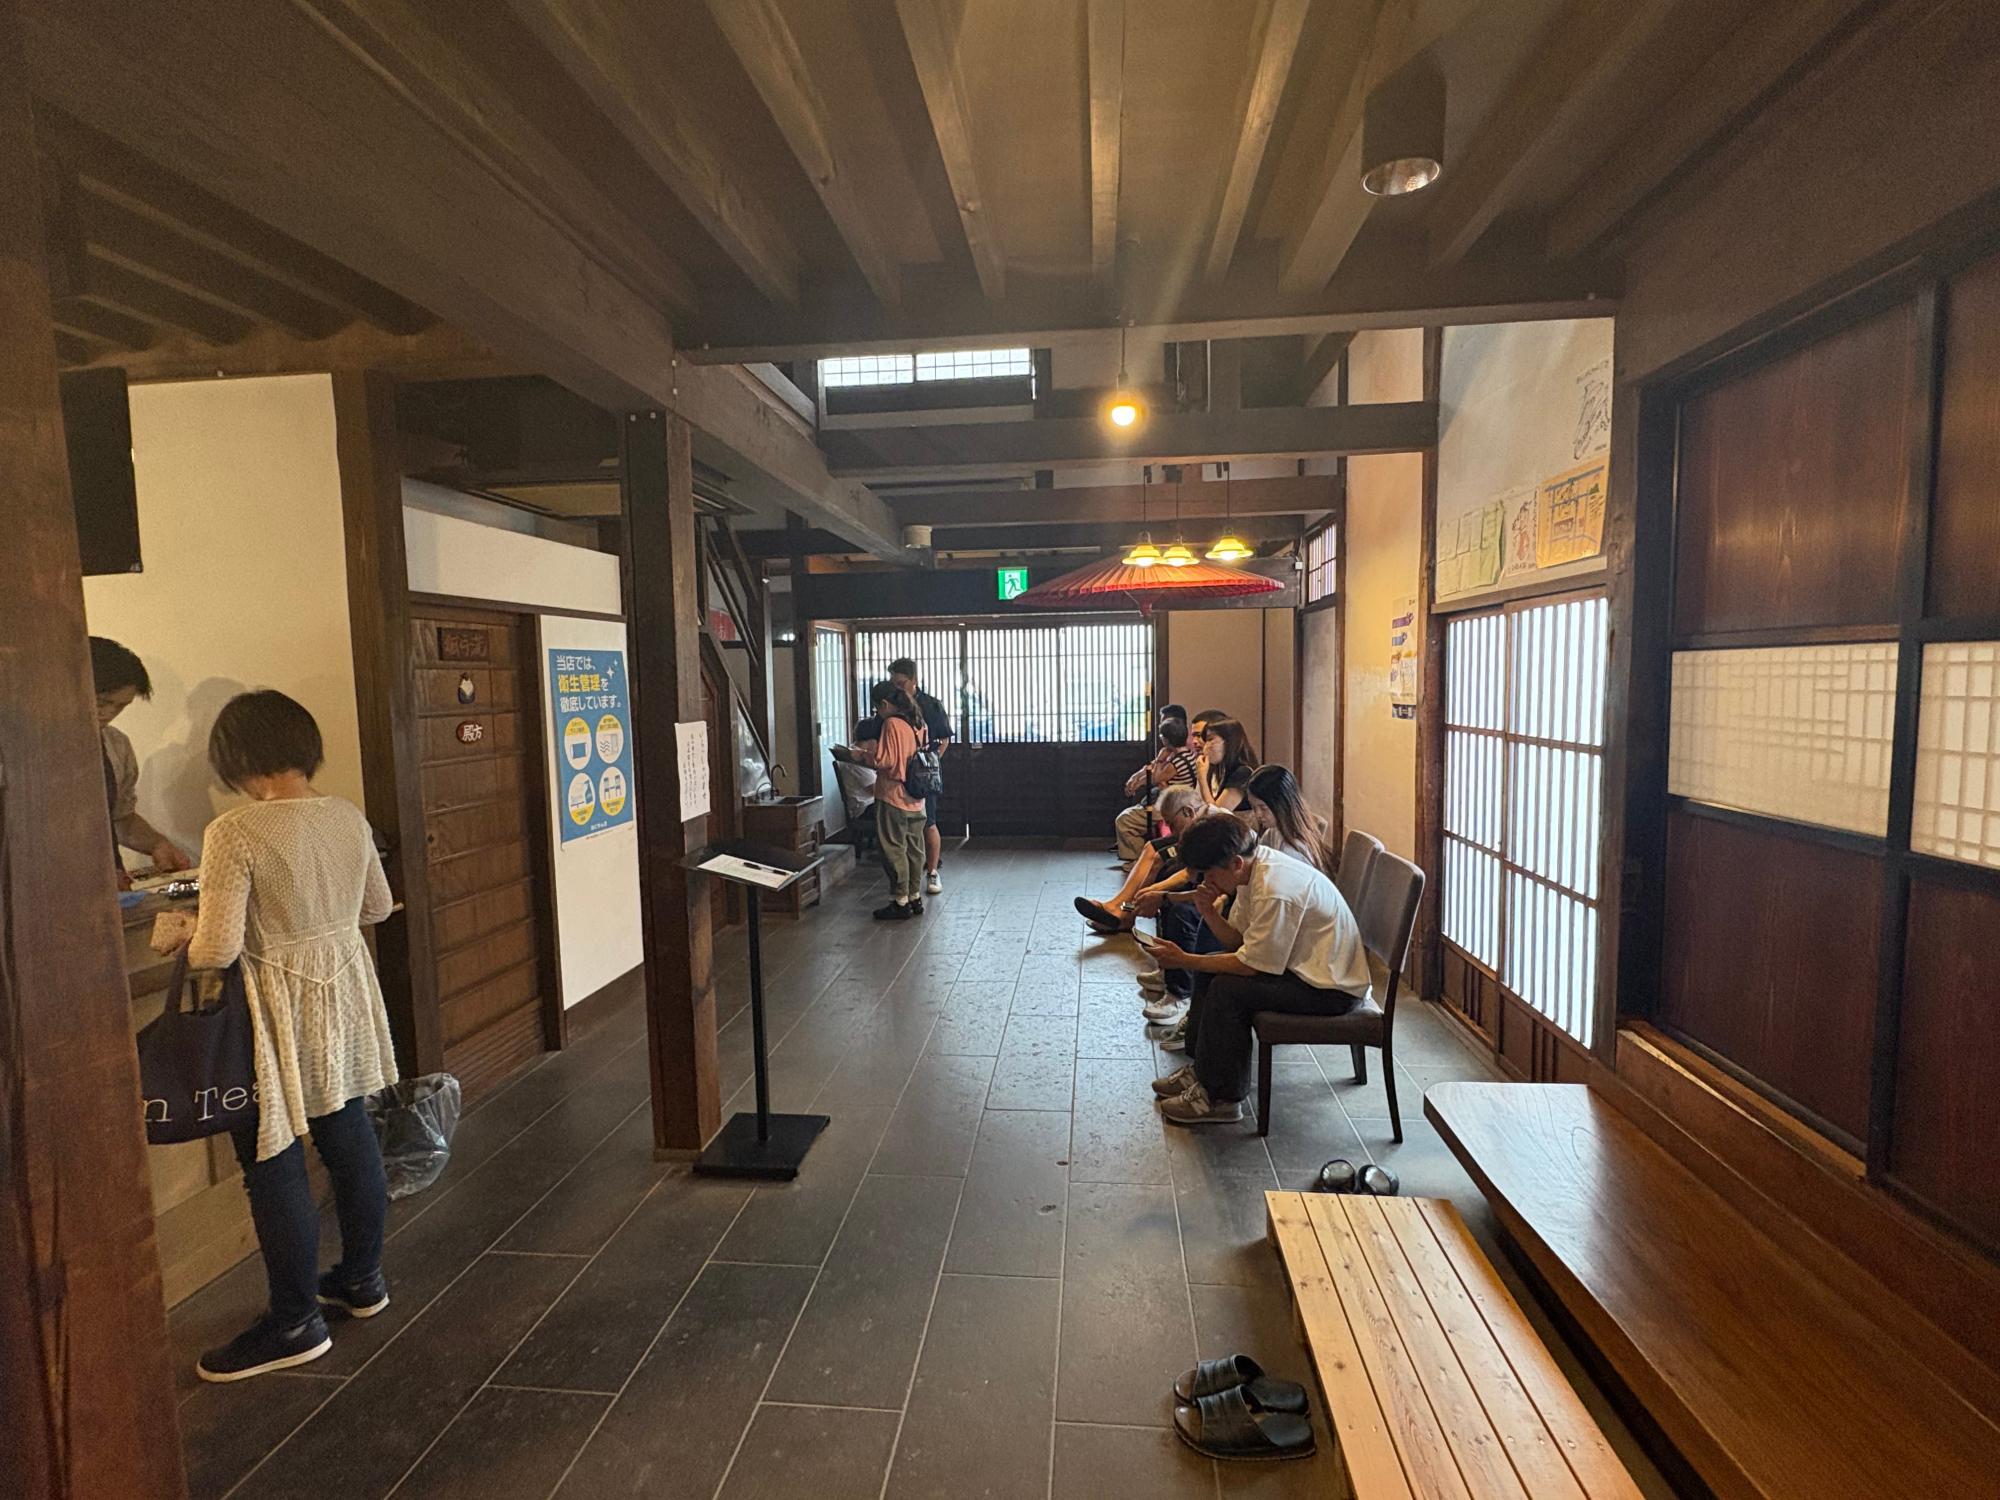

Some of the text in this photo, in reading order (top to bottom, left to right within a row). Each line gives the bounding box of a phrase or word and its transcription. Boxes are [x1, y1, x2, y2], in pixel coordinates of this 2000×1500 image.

[556, 655, 596, 671] 当店では、
[558, 673, 609, 694] 衛生管理を
[560, 694, 622, 713] 徹底しています。
[462, 724, 483, 742] 殿方
